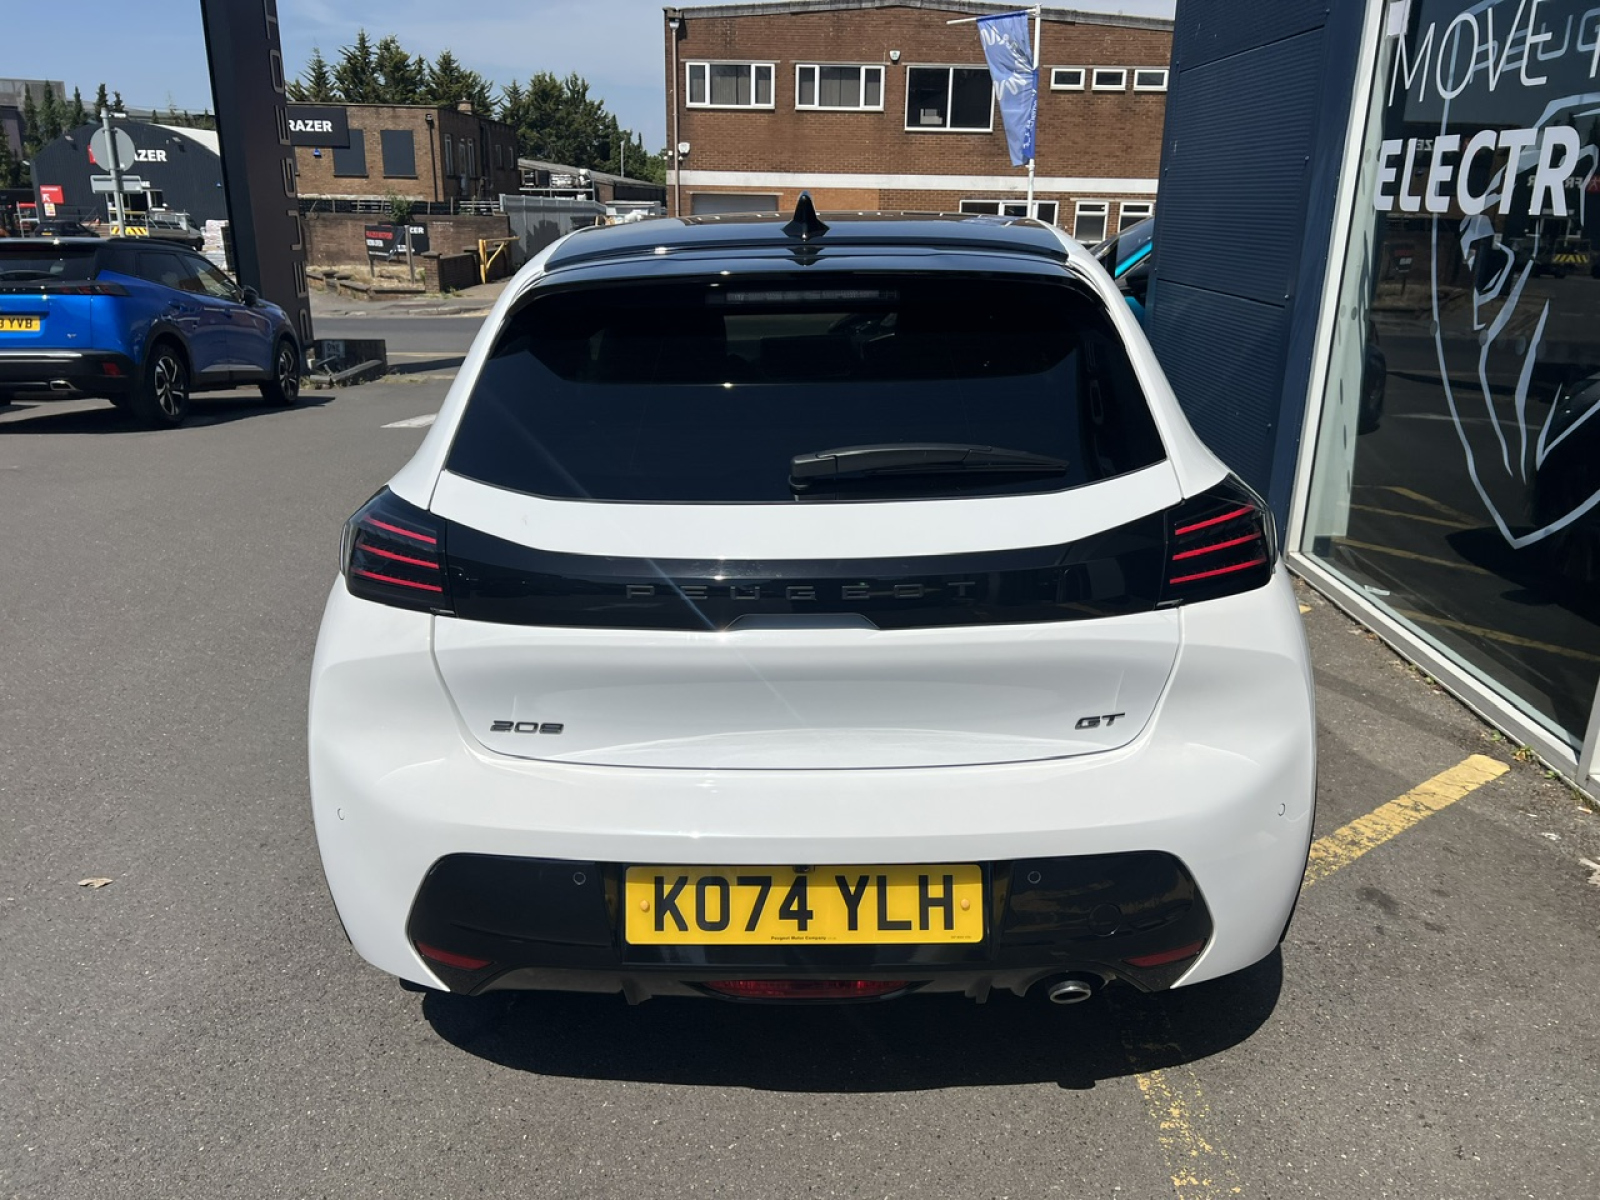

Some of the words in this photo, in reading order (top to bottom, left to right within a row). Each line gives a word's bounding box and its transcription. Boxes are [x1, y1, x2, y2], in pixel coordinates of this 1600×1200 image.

[1388, 0, 1552, 106] MOVE
[1373, 126, 1581, 217] ELECTR
[626, 581, 976, 601] PEUGEOT
[489, 720, 564, 734] 208
[1074, 712, 1126, 730] GT
[654, 875, 814, 932] KO74
[834, 874, 955, 931] YLH
